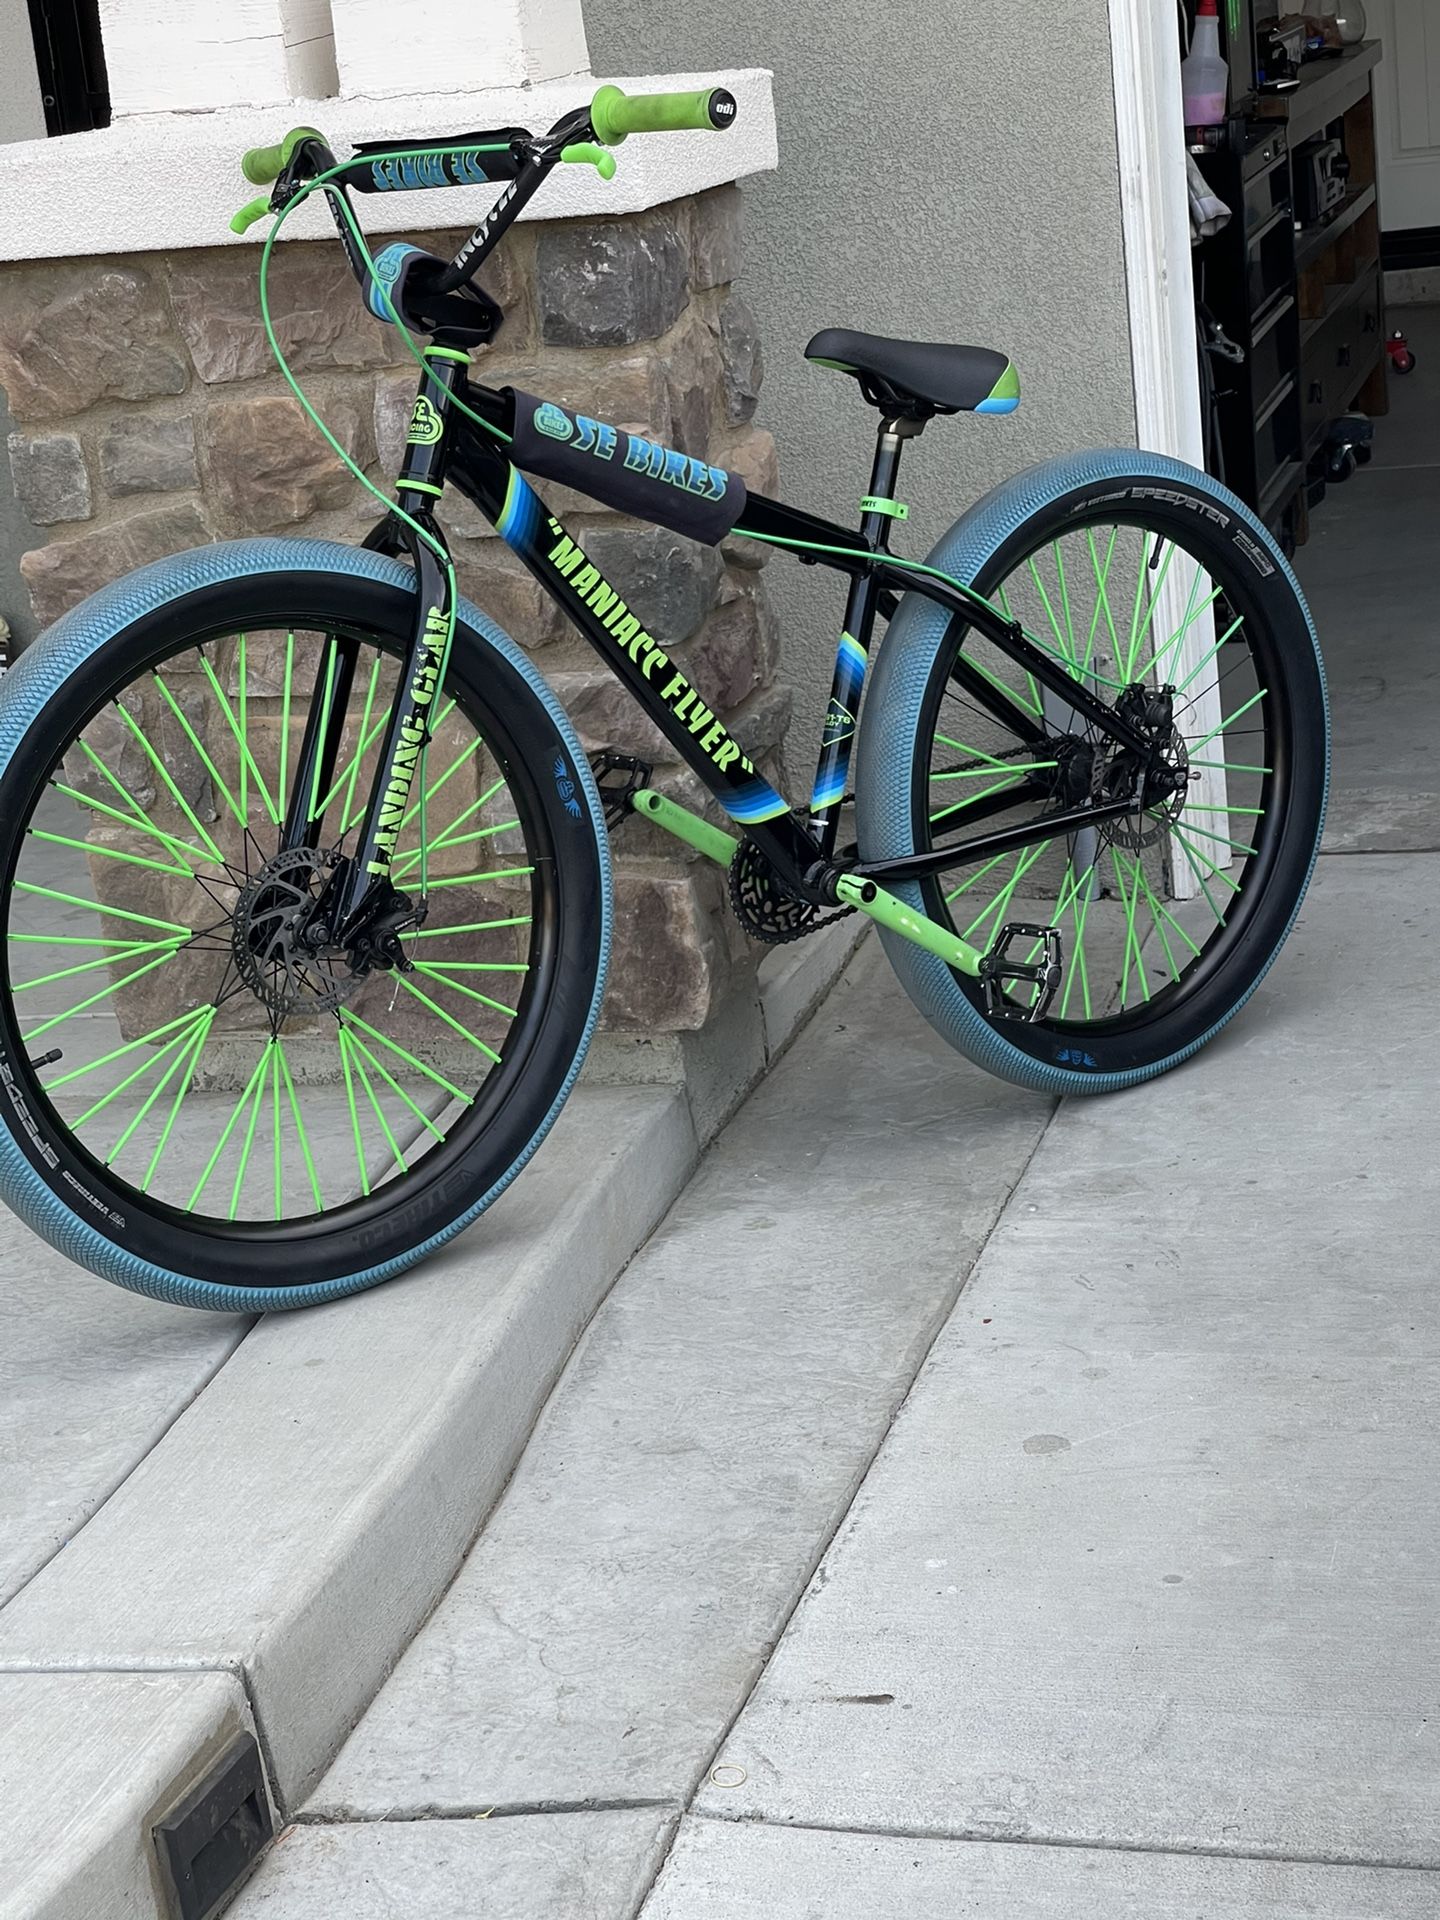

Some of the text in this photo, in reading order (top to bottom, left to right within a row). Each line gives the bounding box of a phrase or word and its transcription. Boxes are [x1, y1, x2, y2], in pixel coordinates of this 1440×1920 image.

[716, 103, 734, 115] odi
[570, 414, 729, 502] SE BIKES
[1130, 486, 1231, 529] SPEEDSTER
[366, 714, 426, 876] LANDING
